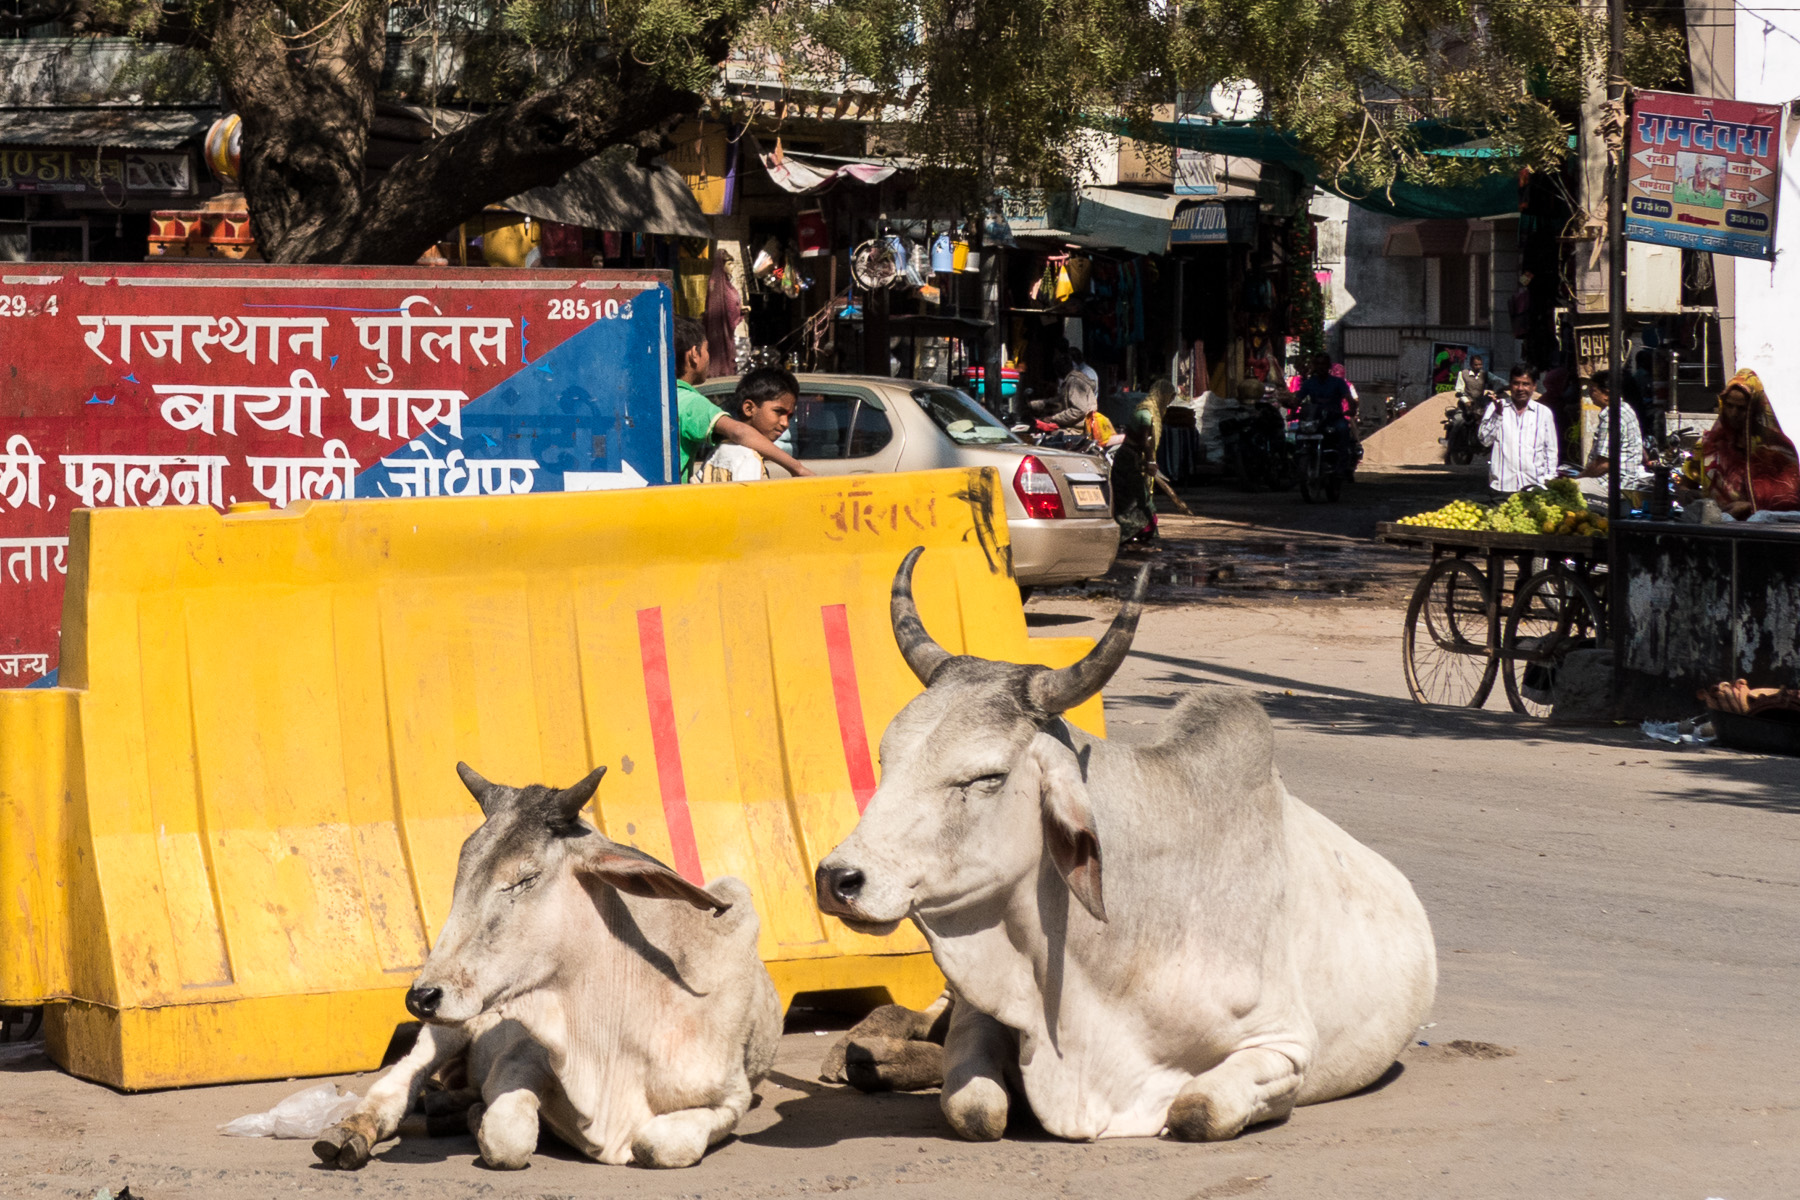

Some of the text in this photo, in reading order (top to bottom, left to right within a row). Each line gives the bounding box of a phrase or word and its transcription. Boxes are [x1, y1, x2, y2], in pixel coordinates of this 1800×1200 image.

[1638, 109, 1773, 157] रामदेवरा
[1636, 201, 1669, 214] 375 km
[1730, 213, 1765, 227] 350 km
[77, 315, 328, 366] राजस्थान
[353, 295, 513, 385] पुलिस
[153, 368, 468, 445] बायी पास
